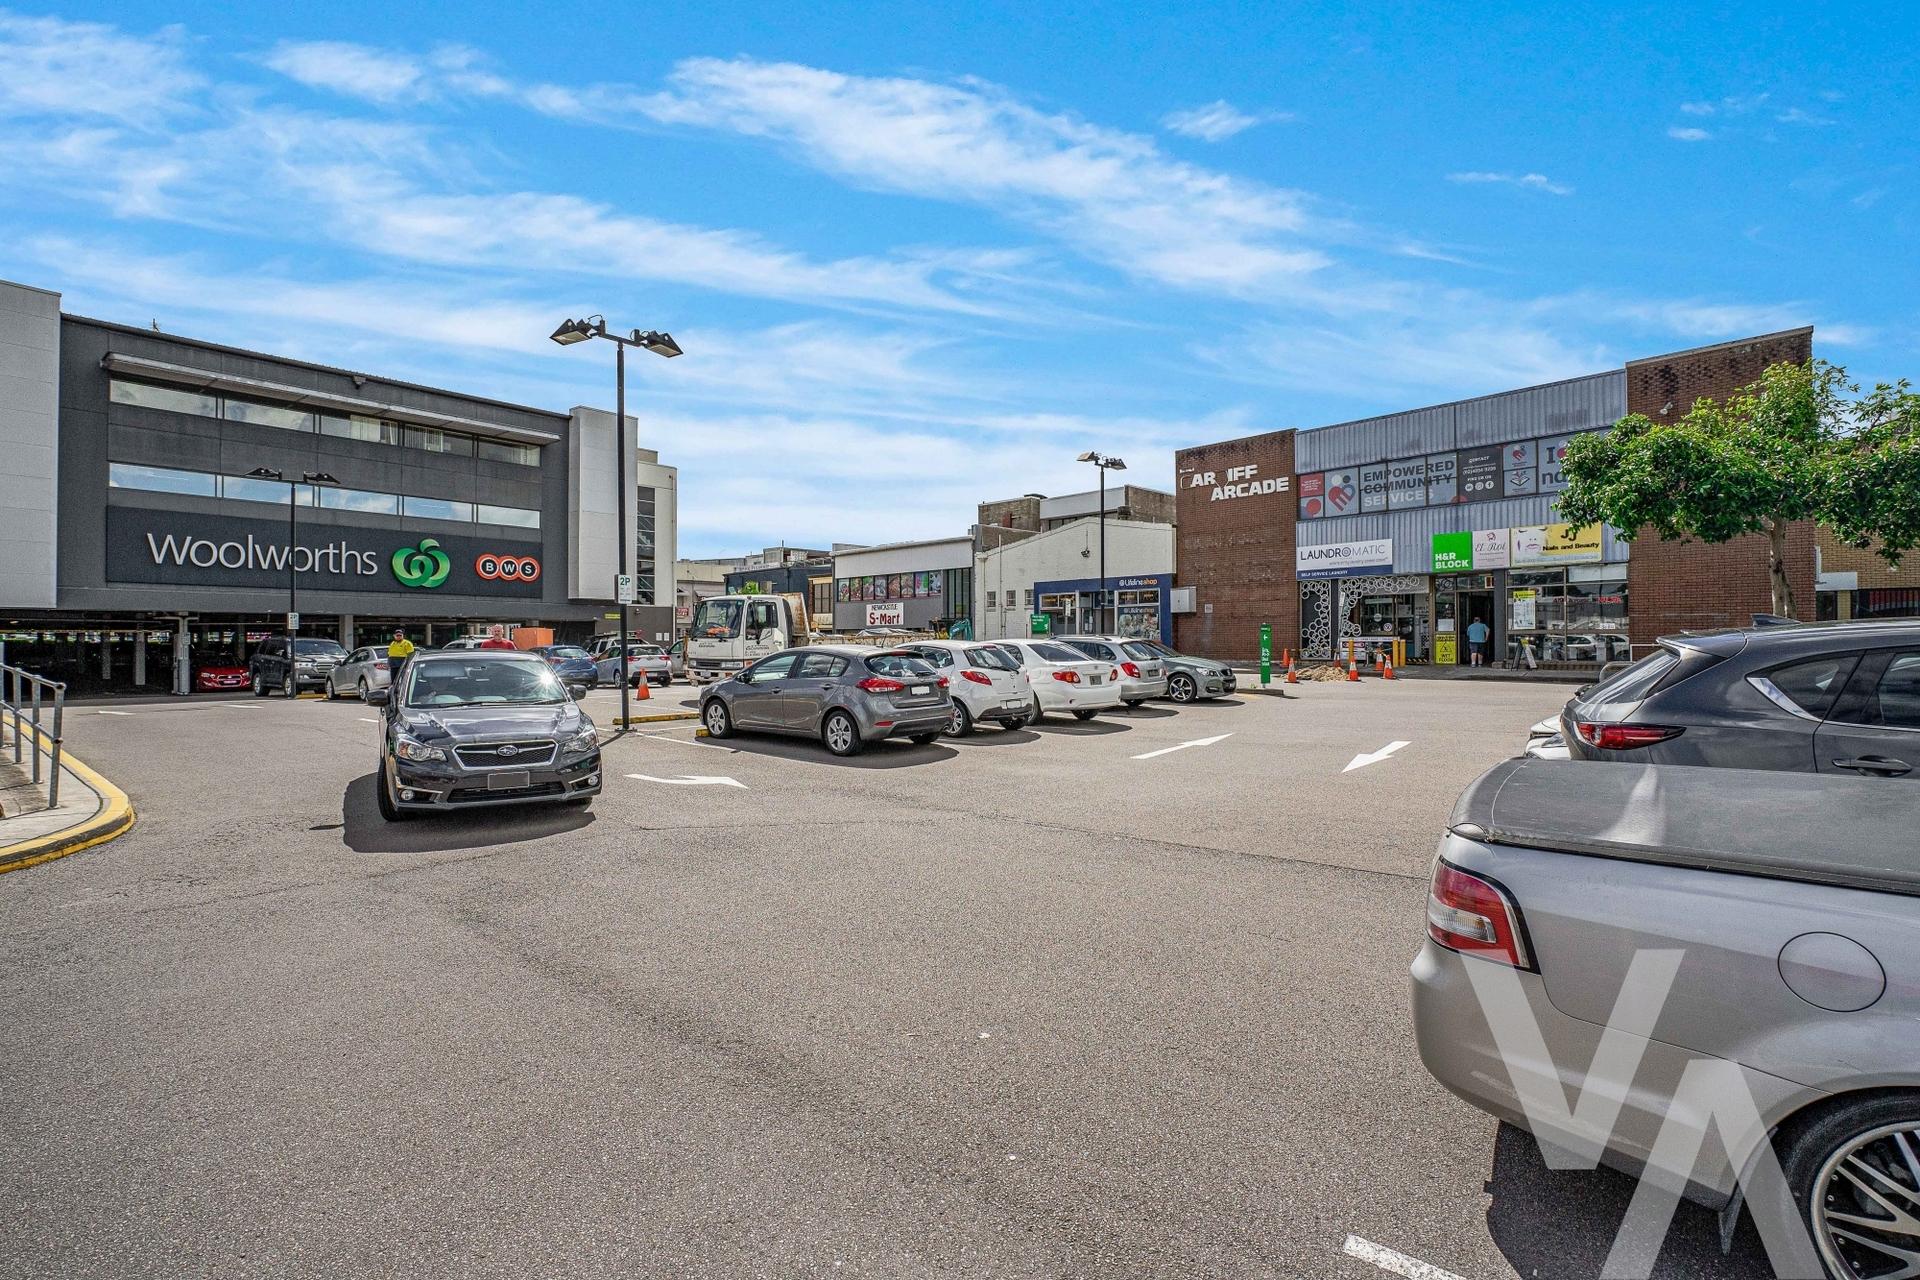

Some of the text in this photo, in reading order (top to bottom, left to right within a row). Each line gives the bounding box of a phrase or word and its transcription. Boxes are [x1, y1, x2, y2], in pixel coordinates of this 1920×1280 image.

[1363, 460, 1455, 482] EMPOWERED
[1211, 476, 1289, 502] ARCADE
[1362, 473, 1453, 494] COMMUNITY
[147, 533, 378, 575] Woolworths
[1300, 544, 1385, 560] LAUNDROMATIC
[1435, 552, 1456, 560] H&R
[485, 562, 532, 574] BWS
[1435, 560, 1469, 569] BLOCK
[620, 577, 631, 586] 2P
[869, 612, 900, 625] S-Mart
